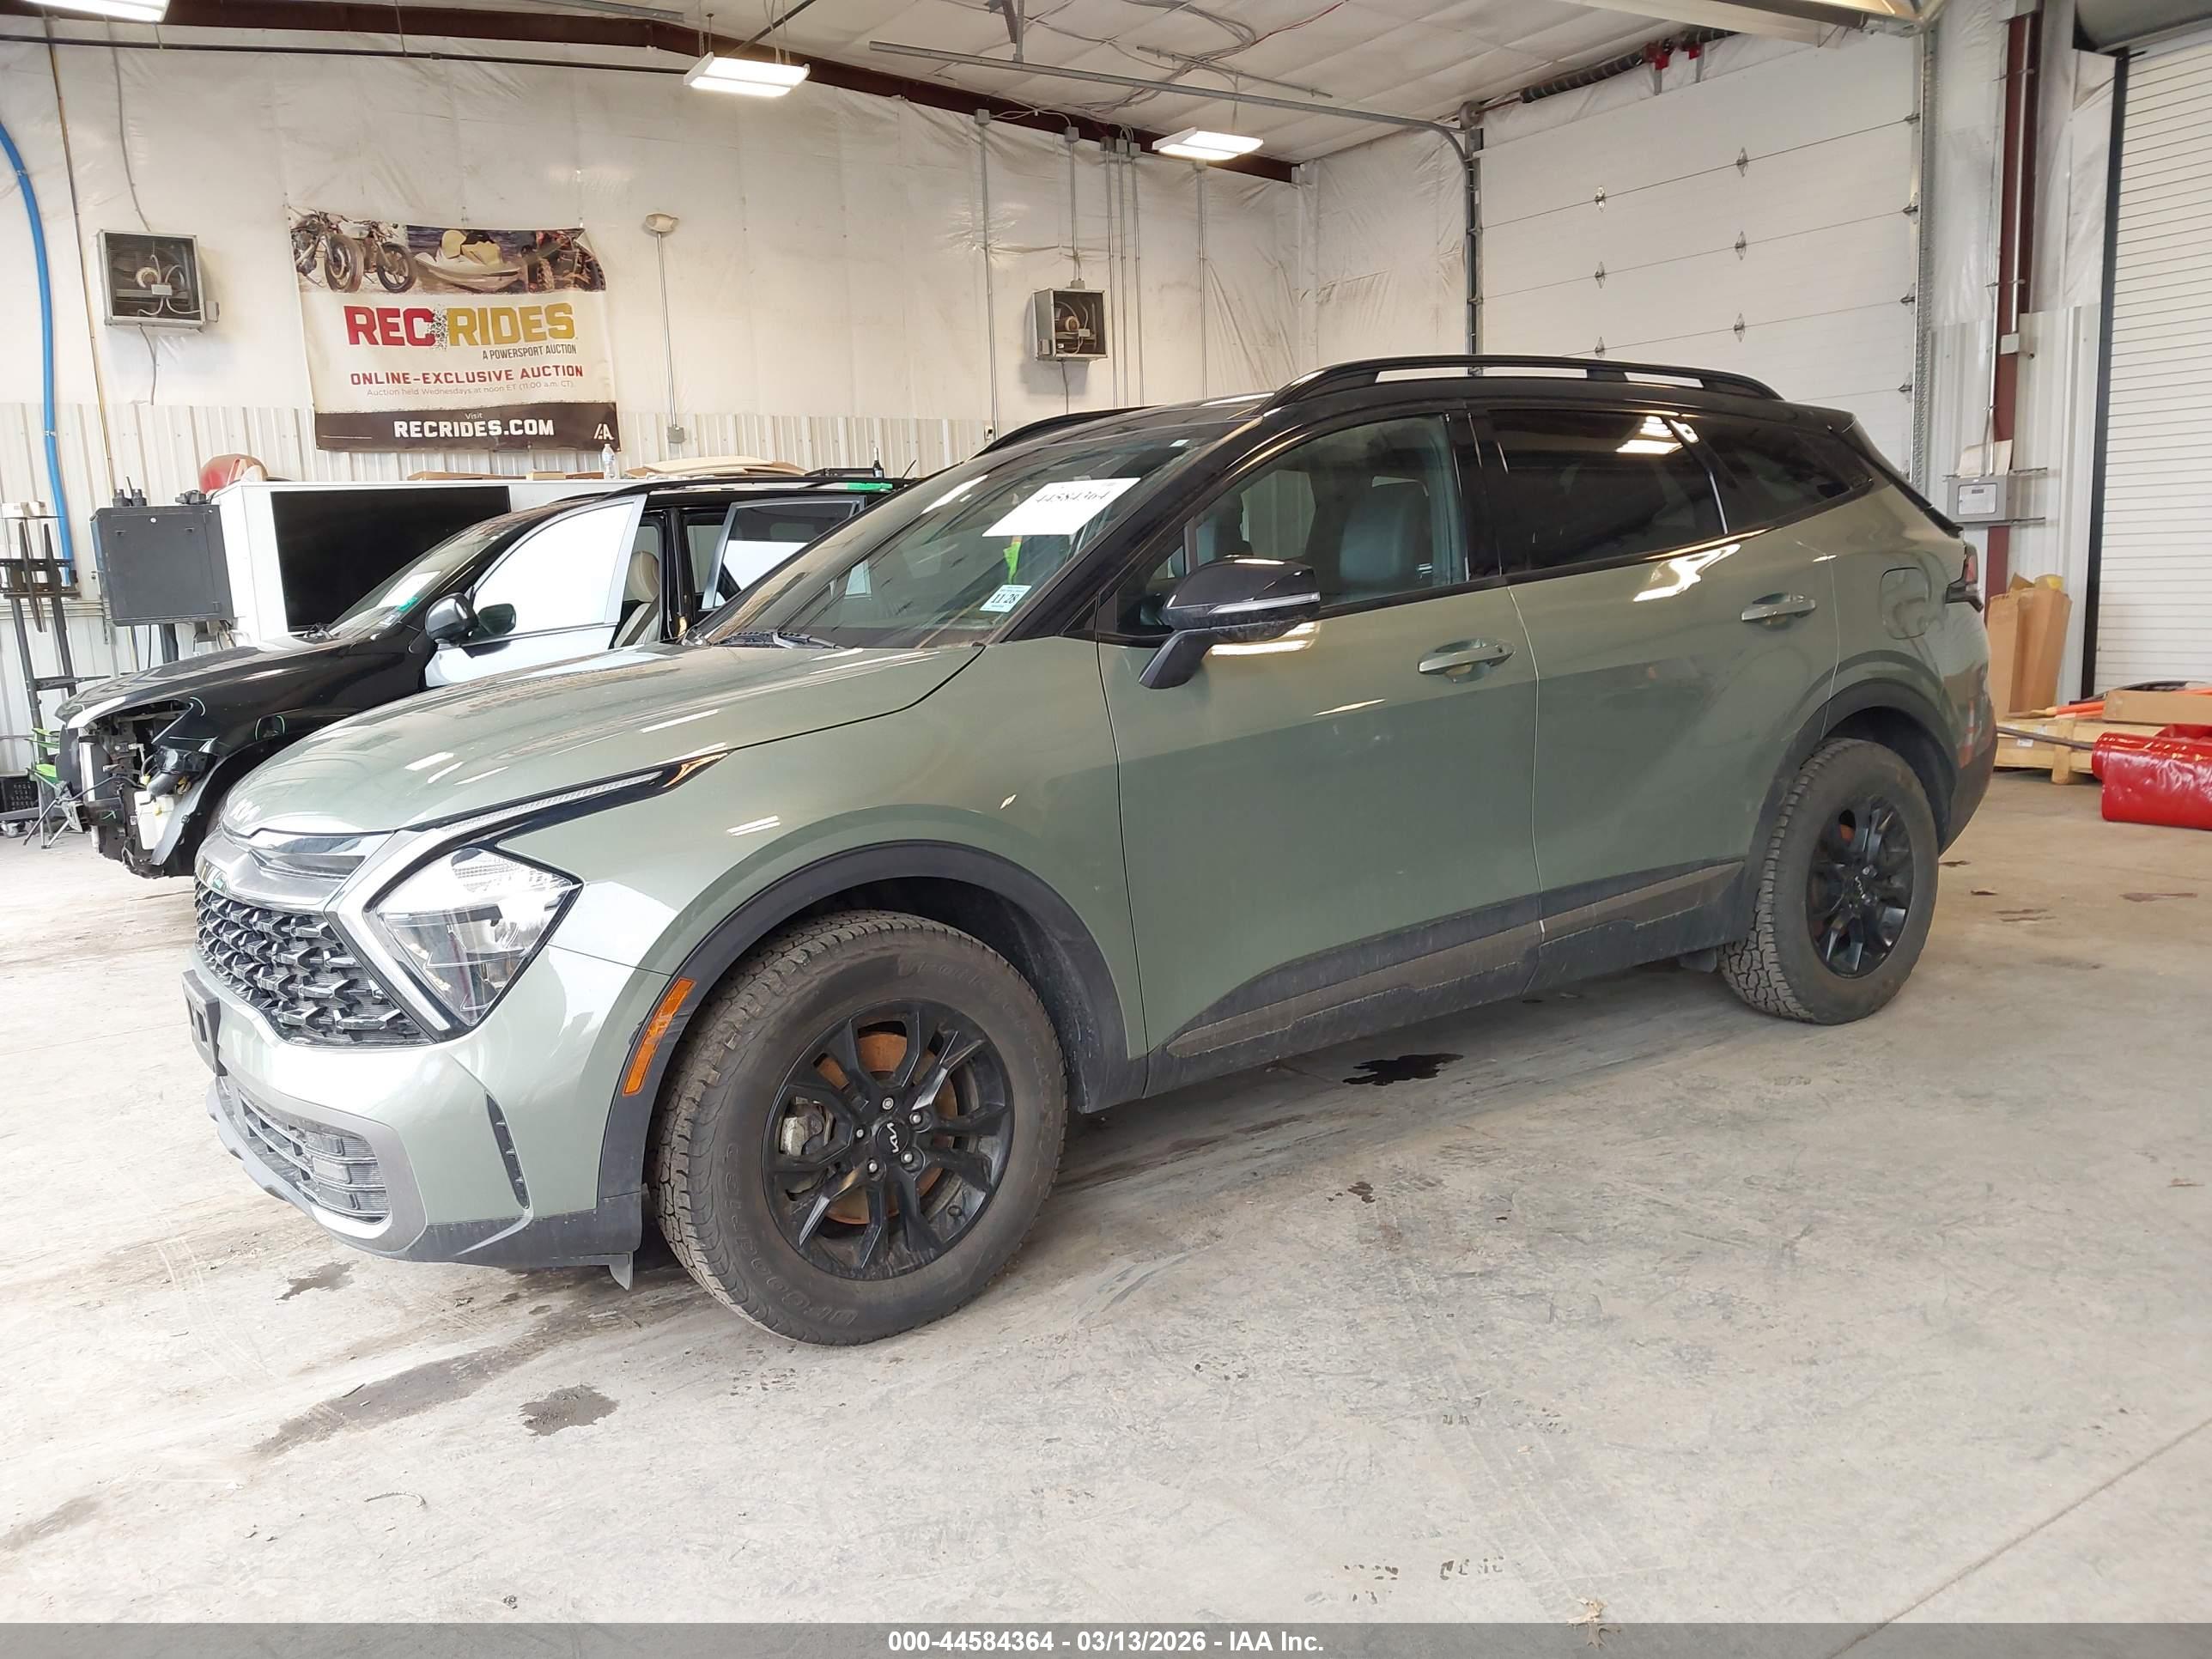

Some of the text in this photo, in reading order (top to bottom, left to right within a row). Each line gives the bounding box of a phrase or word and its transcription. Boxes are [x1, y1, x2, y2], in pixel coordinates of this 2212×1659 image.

[343, 302, 575, 347] REC RIDES
[483, 343, 577, 360] A POWERSPORT AUCTION
[350, 365, 584, 386] ONLINE-EXCLUSIVE AUCTION
[367, 388, 400, 397] Auction
[421, 386, 472, 397] Wednesdays
[474, 386, 482, 394] at
[393, 419, 555, 438] RECRIDES.COM
